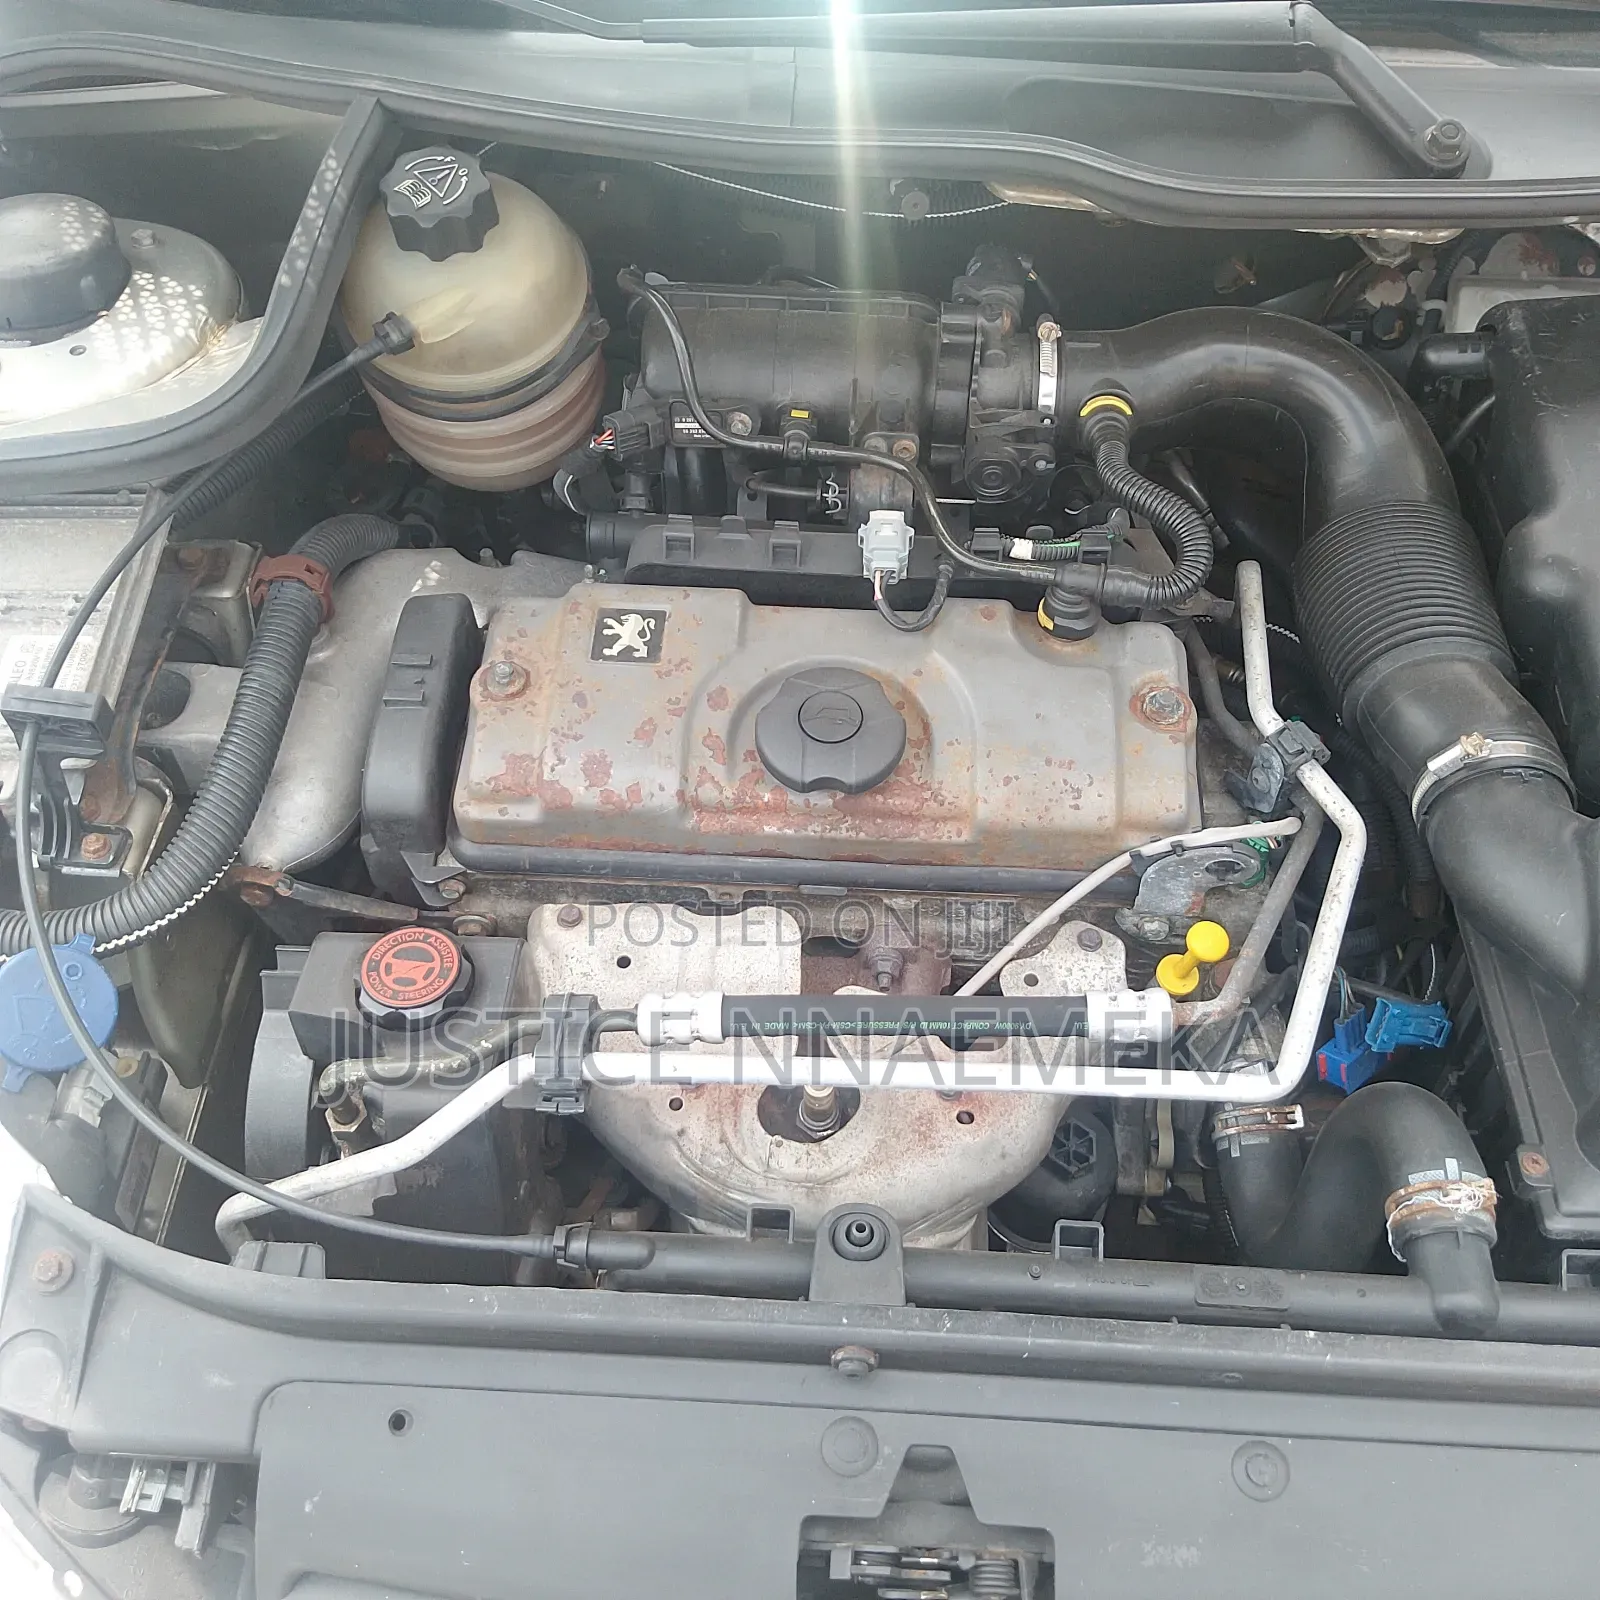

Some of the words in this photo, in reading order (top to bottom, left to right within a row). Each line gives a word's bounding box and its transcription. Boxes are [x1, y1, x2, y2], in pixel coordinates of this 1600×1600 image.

[371, 932, 425, 960] DIRECTION
[426, 934, 454, 968] ASSISTEE
[368, 971, 393, 998] POWER
[396, 977, 445, 1001] STEERING
[751, 1022, 761, 1030] IN
[764, 1021, 790, 1030] MADE
